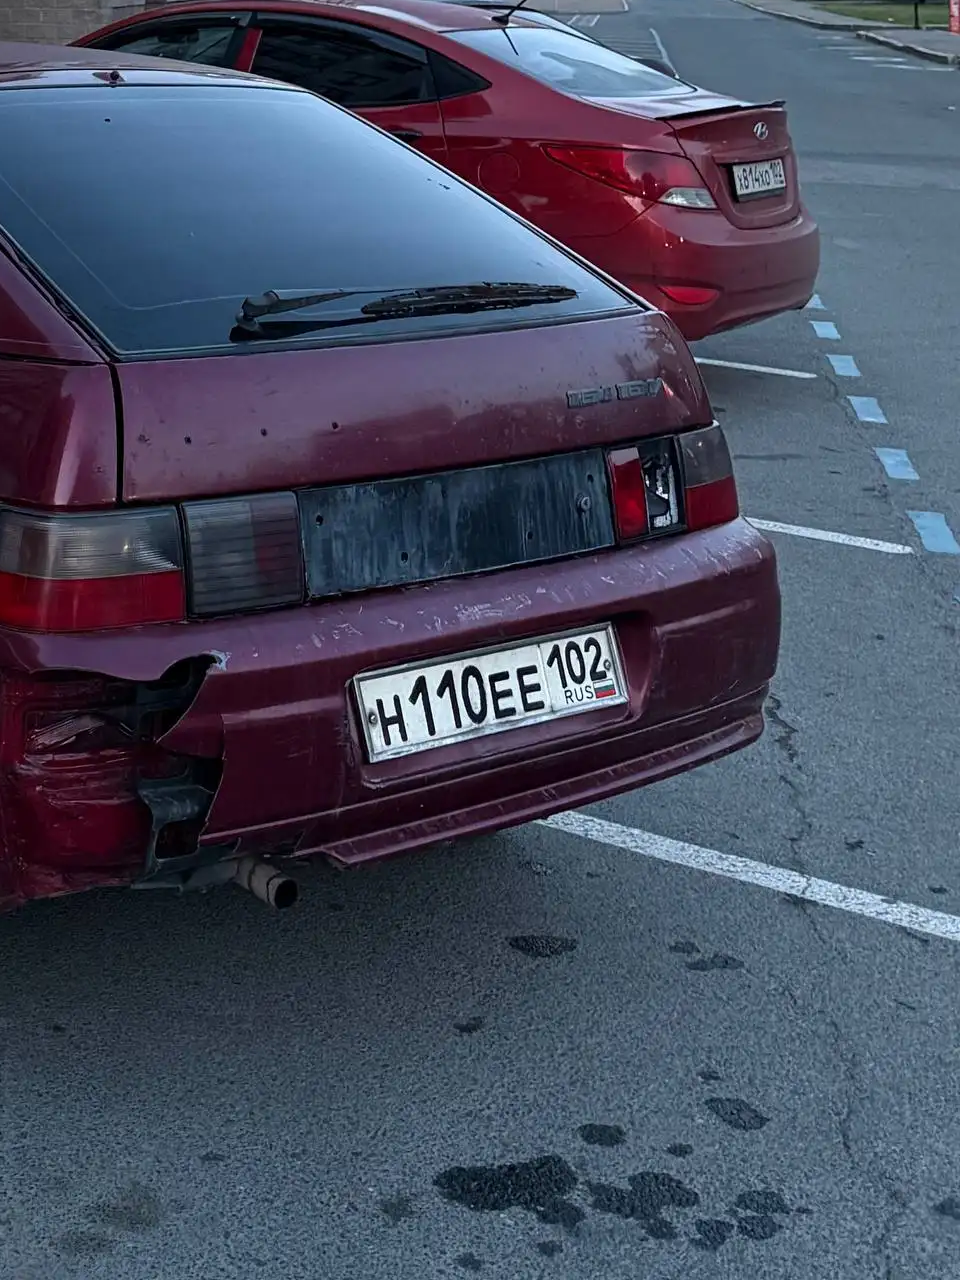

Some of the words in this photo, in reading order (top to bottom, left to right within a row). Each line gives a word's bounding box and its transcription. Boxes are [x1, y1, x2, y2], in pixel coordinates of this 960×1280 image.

[376, 665, 545, 746] Н110ЕЕ
[547, 637, 608, 689] 102
[564, 685, 594, 704] RUS
